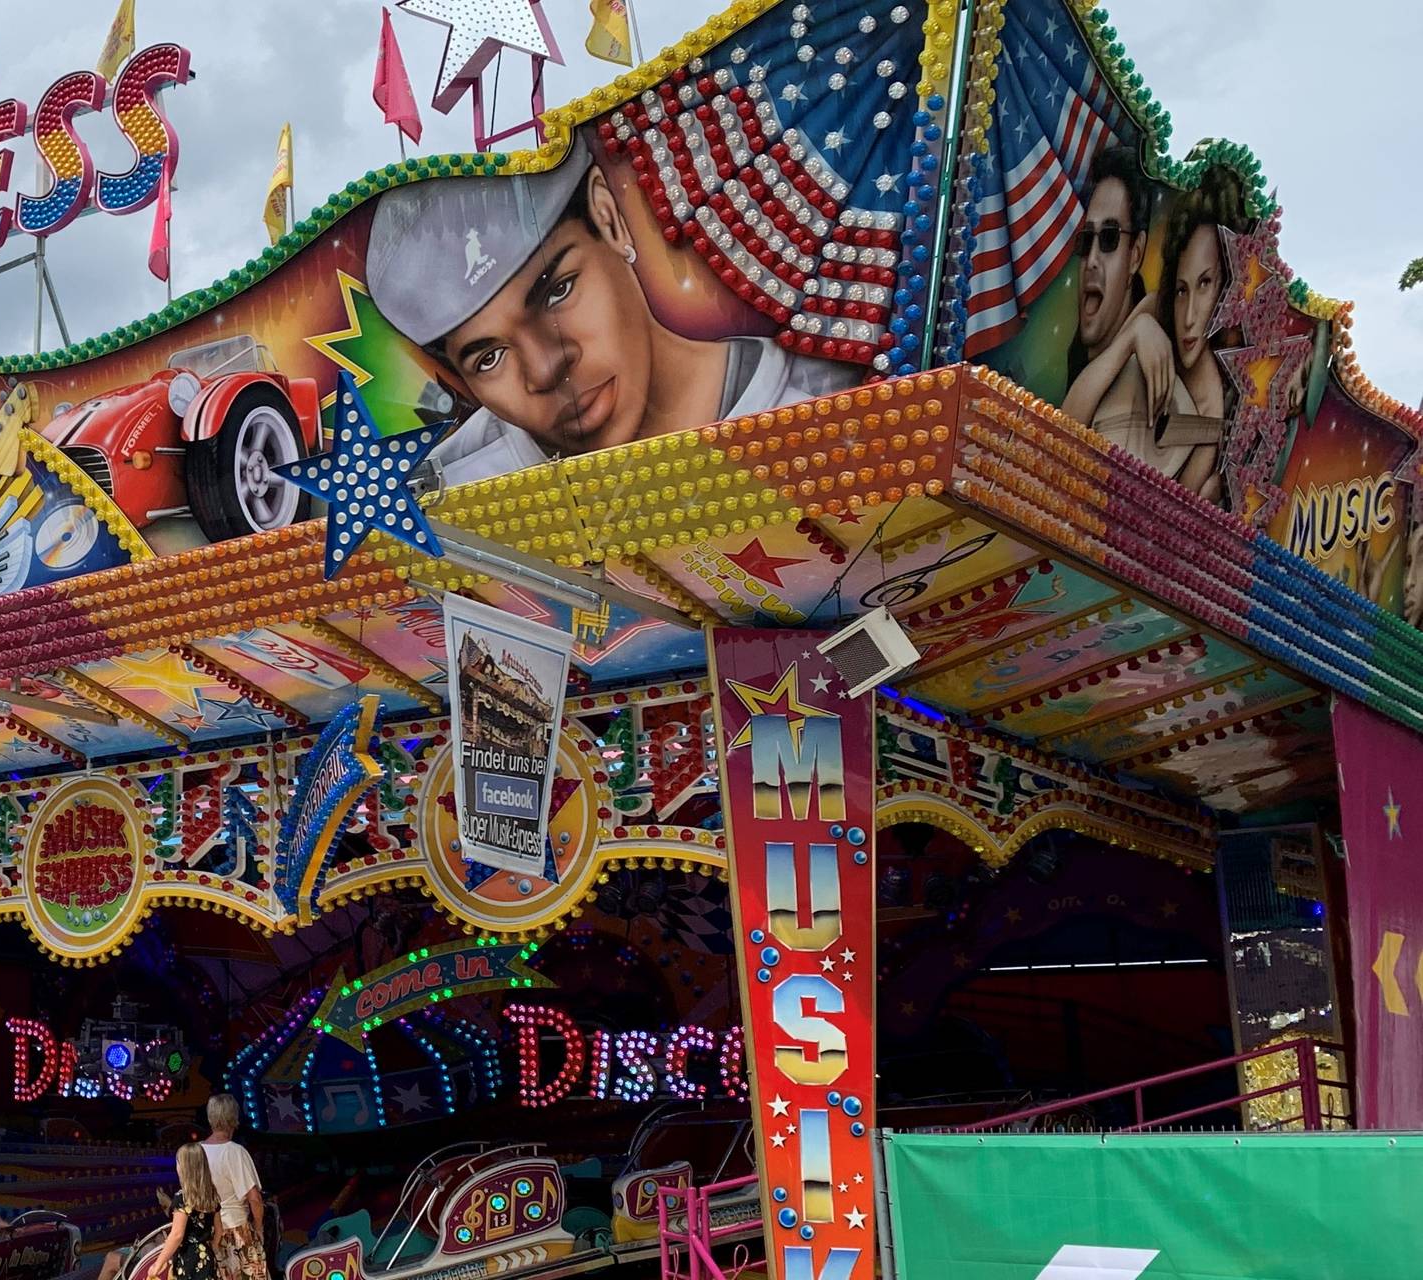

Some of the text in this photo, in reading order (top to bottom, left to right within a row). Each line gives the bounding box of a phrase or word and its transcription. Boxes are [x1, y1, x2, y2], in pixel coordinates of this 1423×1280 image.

[120, 410, 157, 457] FORMEL
[1287, 476, 1397, 562] MUSIC
[461, 741, 547, 776] Findet uns bei
[481, 782, 534, 810] facebook
[39, 805, 127, 859] MUSIK
[461, 807, 542, 857] Super Musik-Express
[34, 853, 134, 909] EXPRESS
[356, 954, 493, 1018] come in
[493, 1213, 508, 1228] 13
